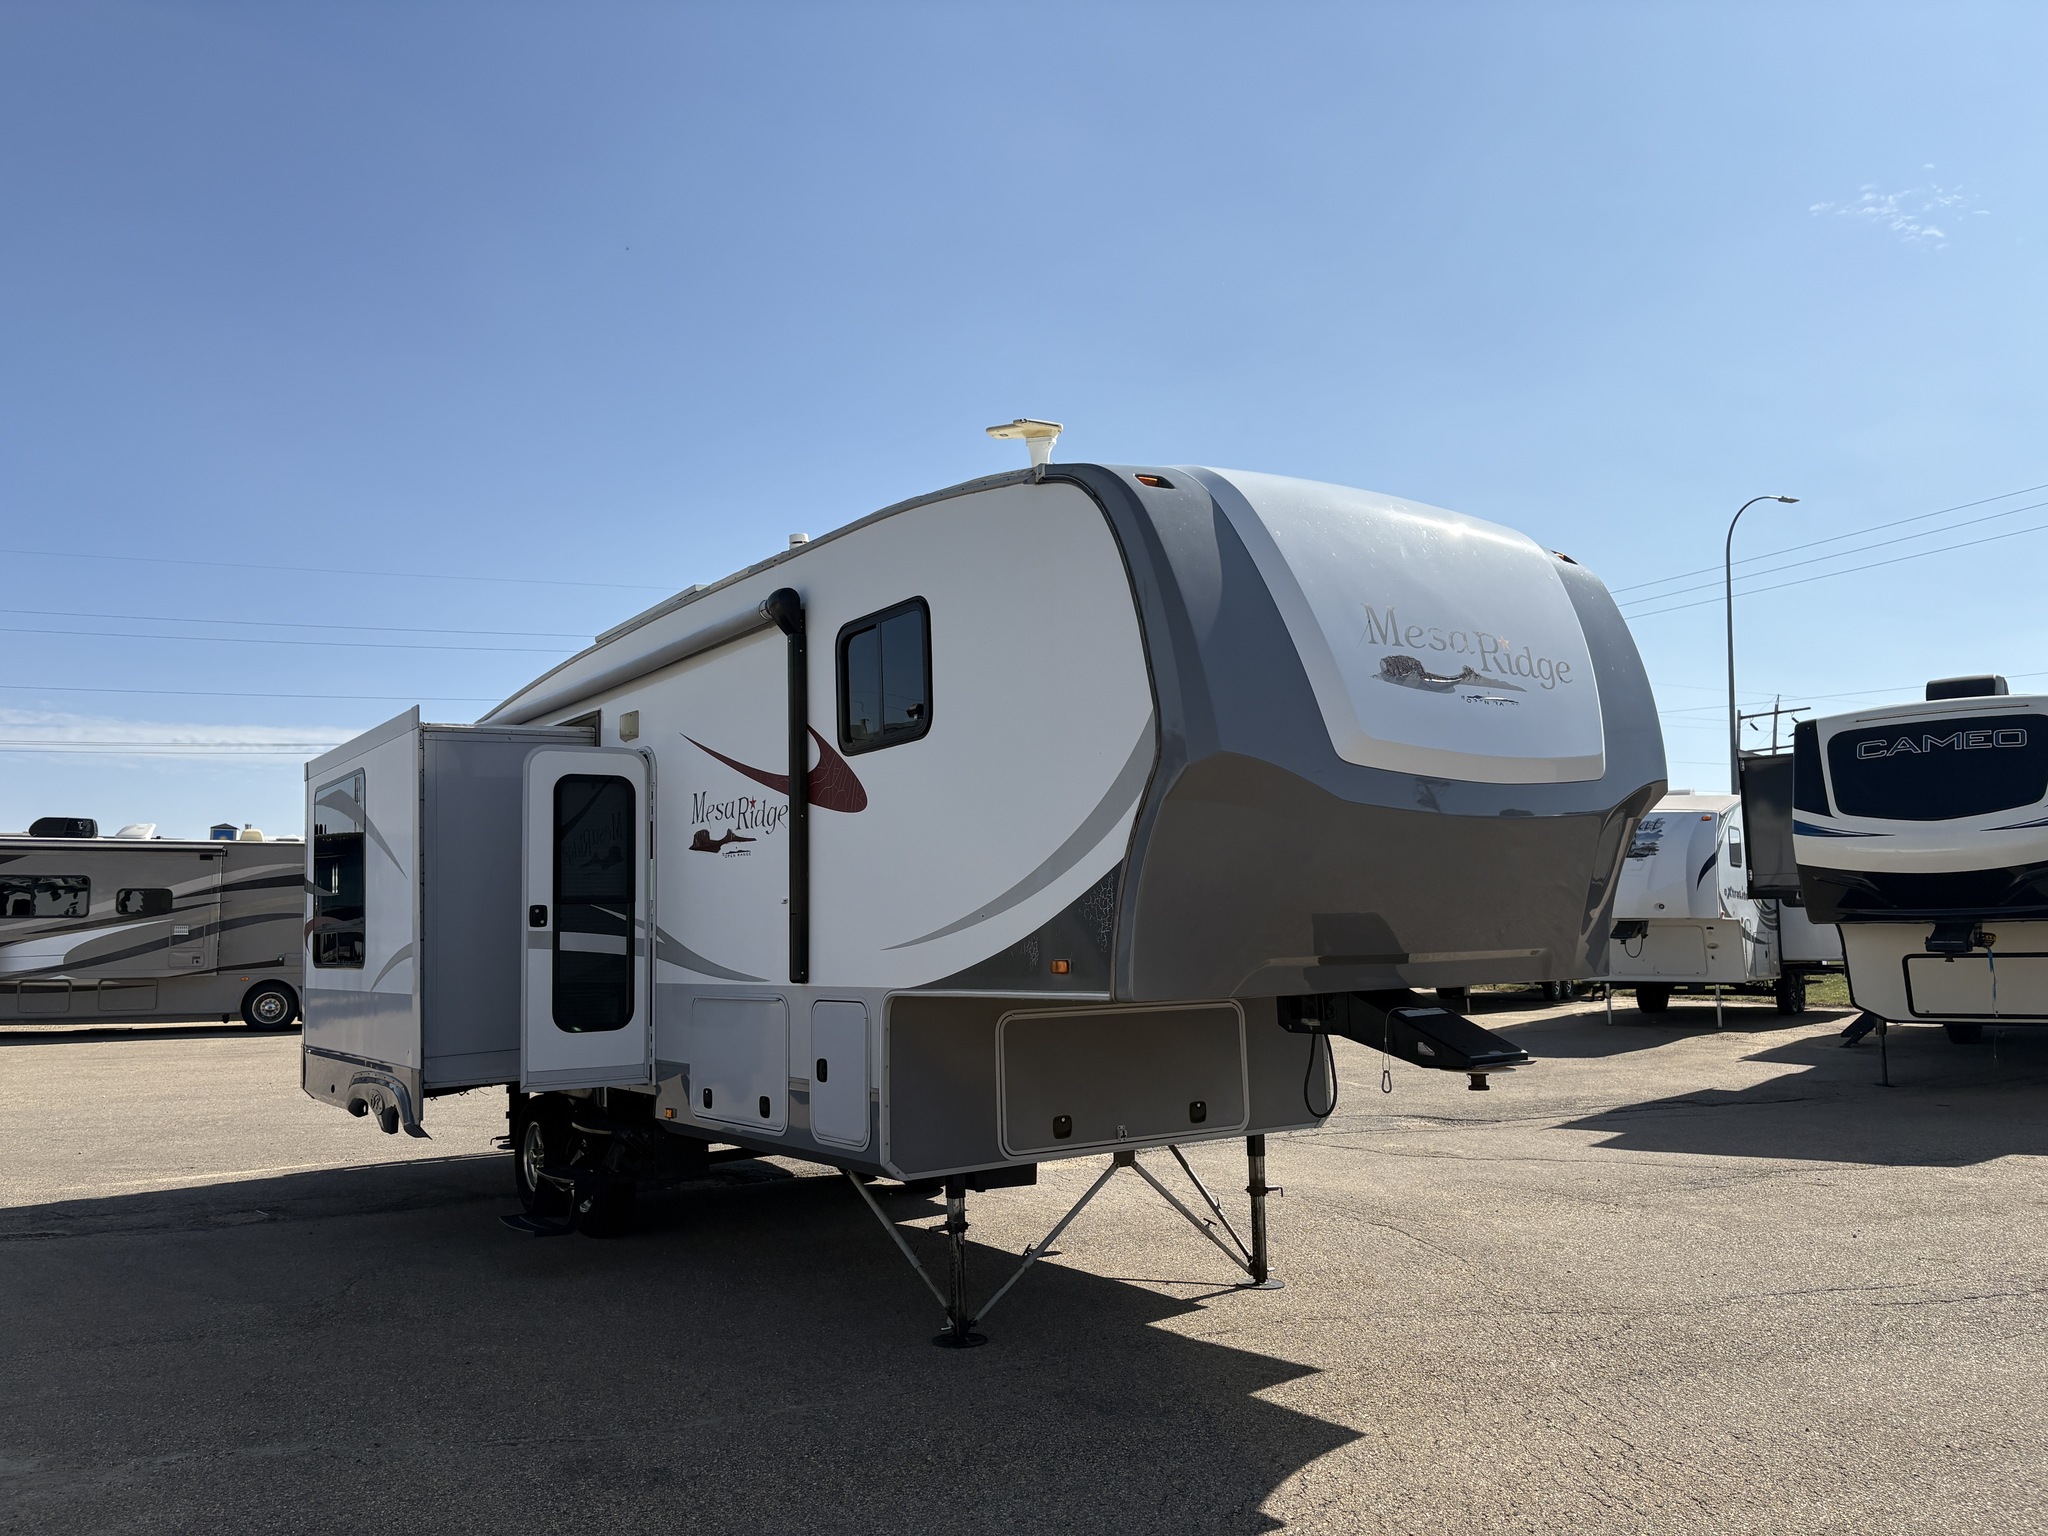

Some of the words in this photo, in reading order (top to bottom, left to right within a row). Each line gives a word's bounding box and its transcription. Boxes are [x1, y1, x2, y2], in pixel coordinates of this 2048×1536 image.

[1360, 603, 1475, 654] Mesa
[1473, 631, 1573, 690] Ridge
[1856, 728, 2028, 760] CAMEO
[691, 790, 736, 829] Mesa
[735, 795, 789, 835] Ridge
